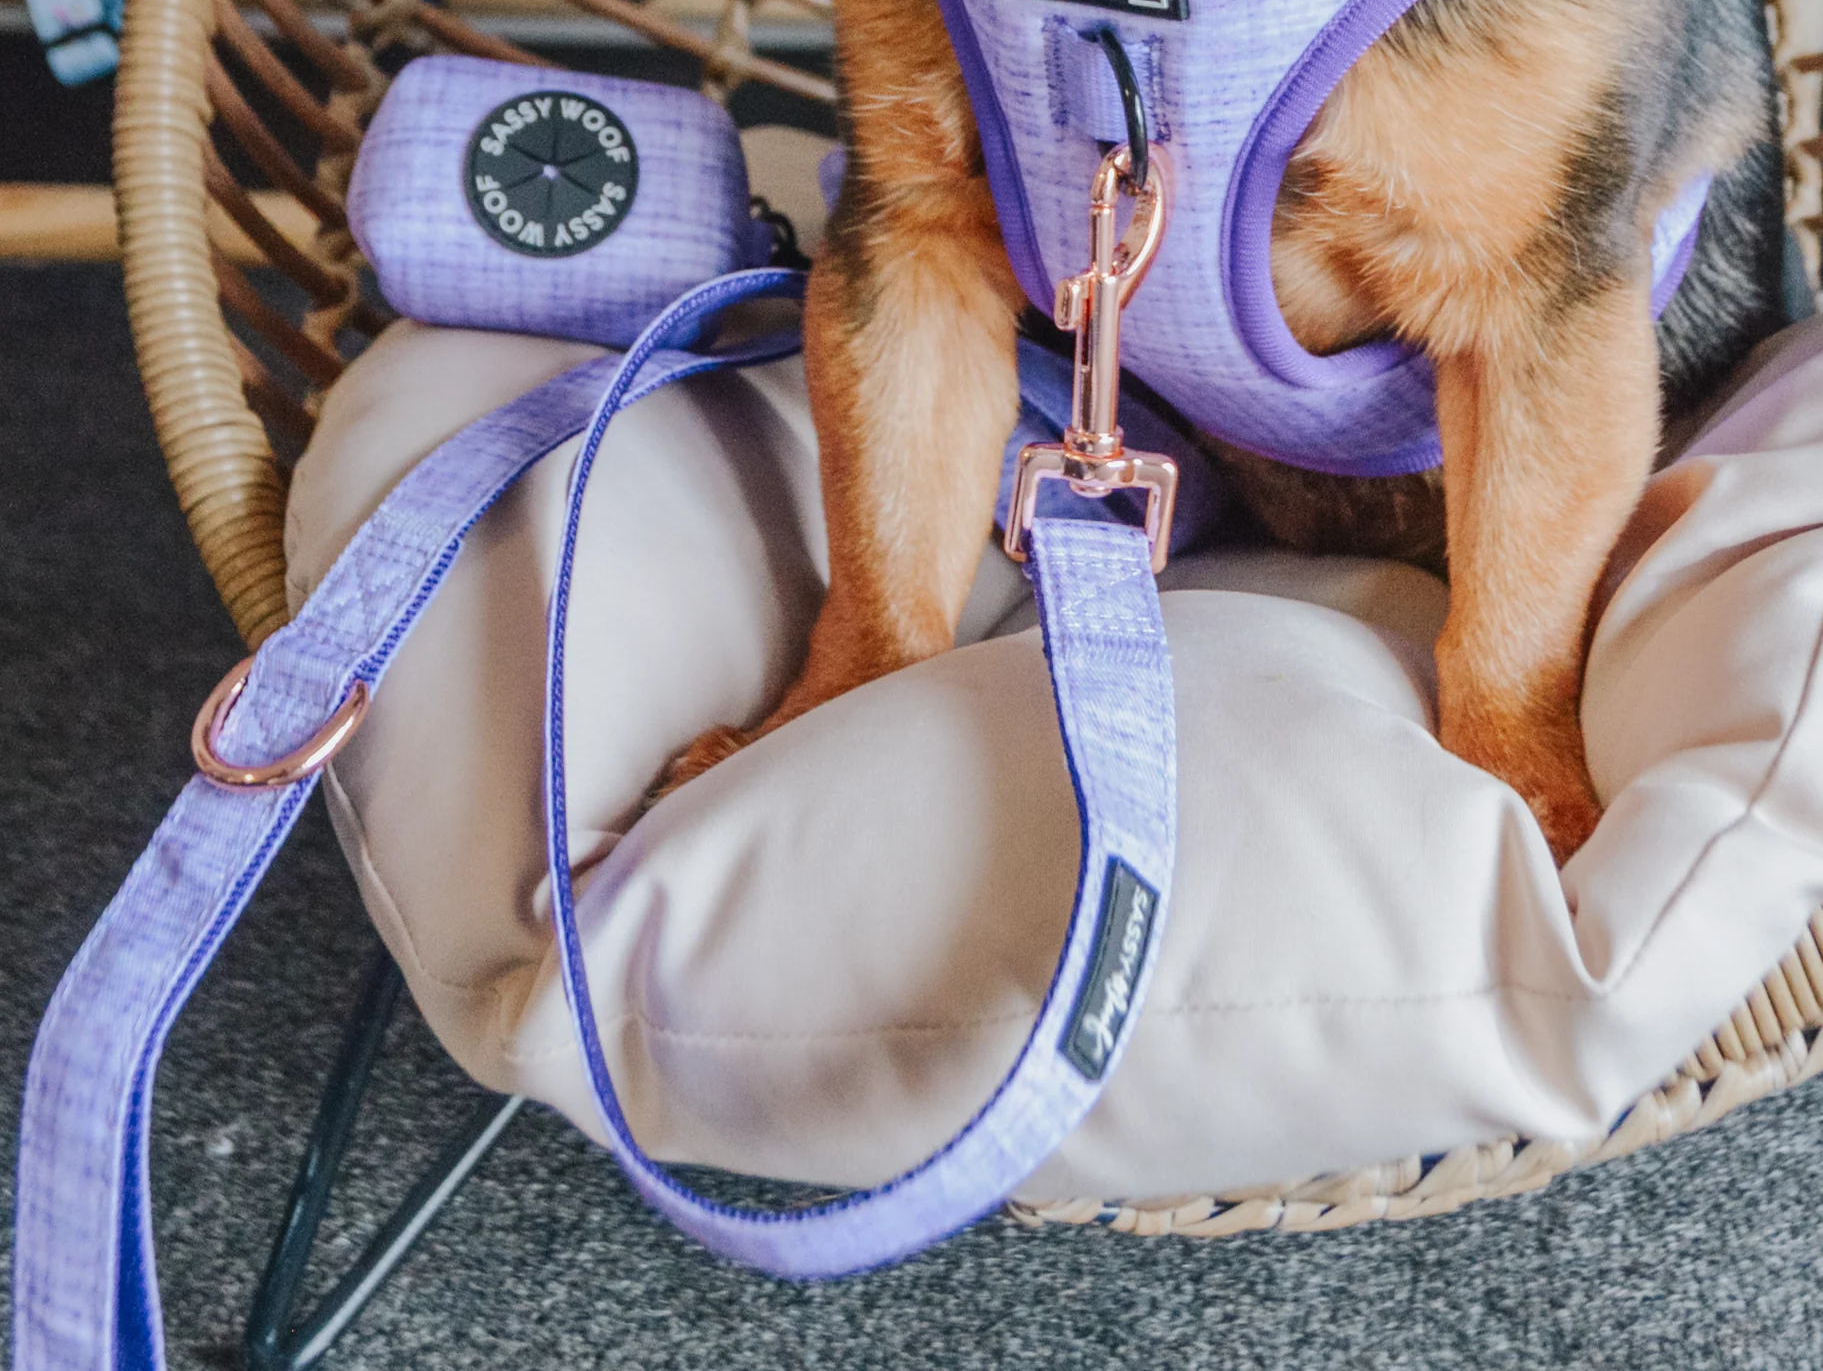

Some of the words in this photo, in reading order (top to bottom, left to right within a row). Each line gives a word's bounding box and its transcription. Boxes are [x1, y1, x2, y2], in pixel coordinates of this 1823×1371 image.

[480, 98, 553, 157] SASSY
[560, 98, 631, 163] WOOF
[475, 175, 545, 247] WOOF
[554, 181, 627, 247] SASSY
[1119, 884, 1148, 977] SASSY
